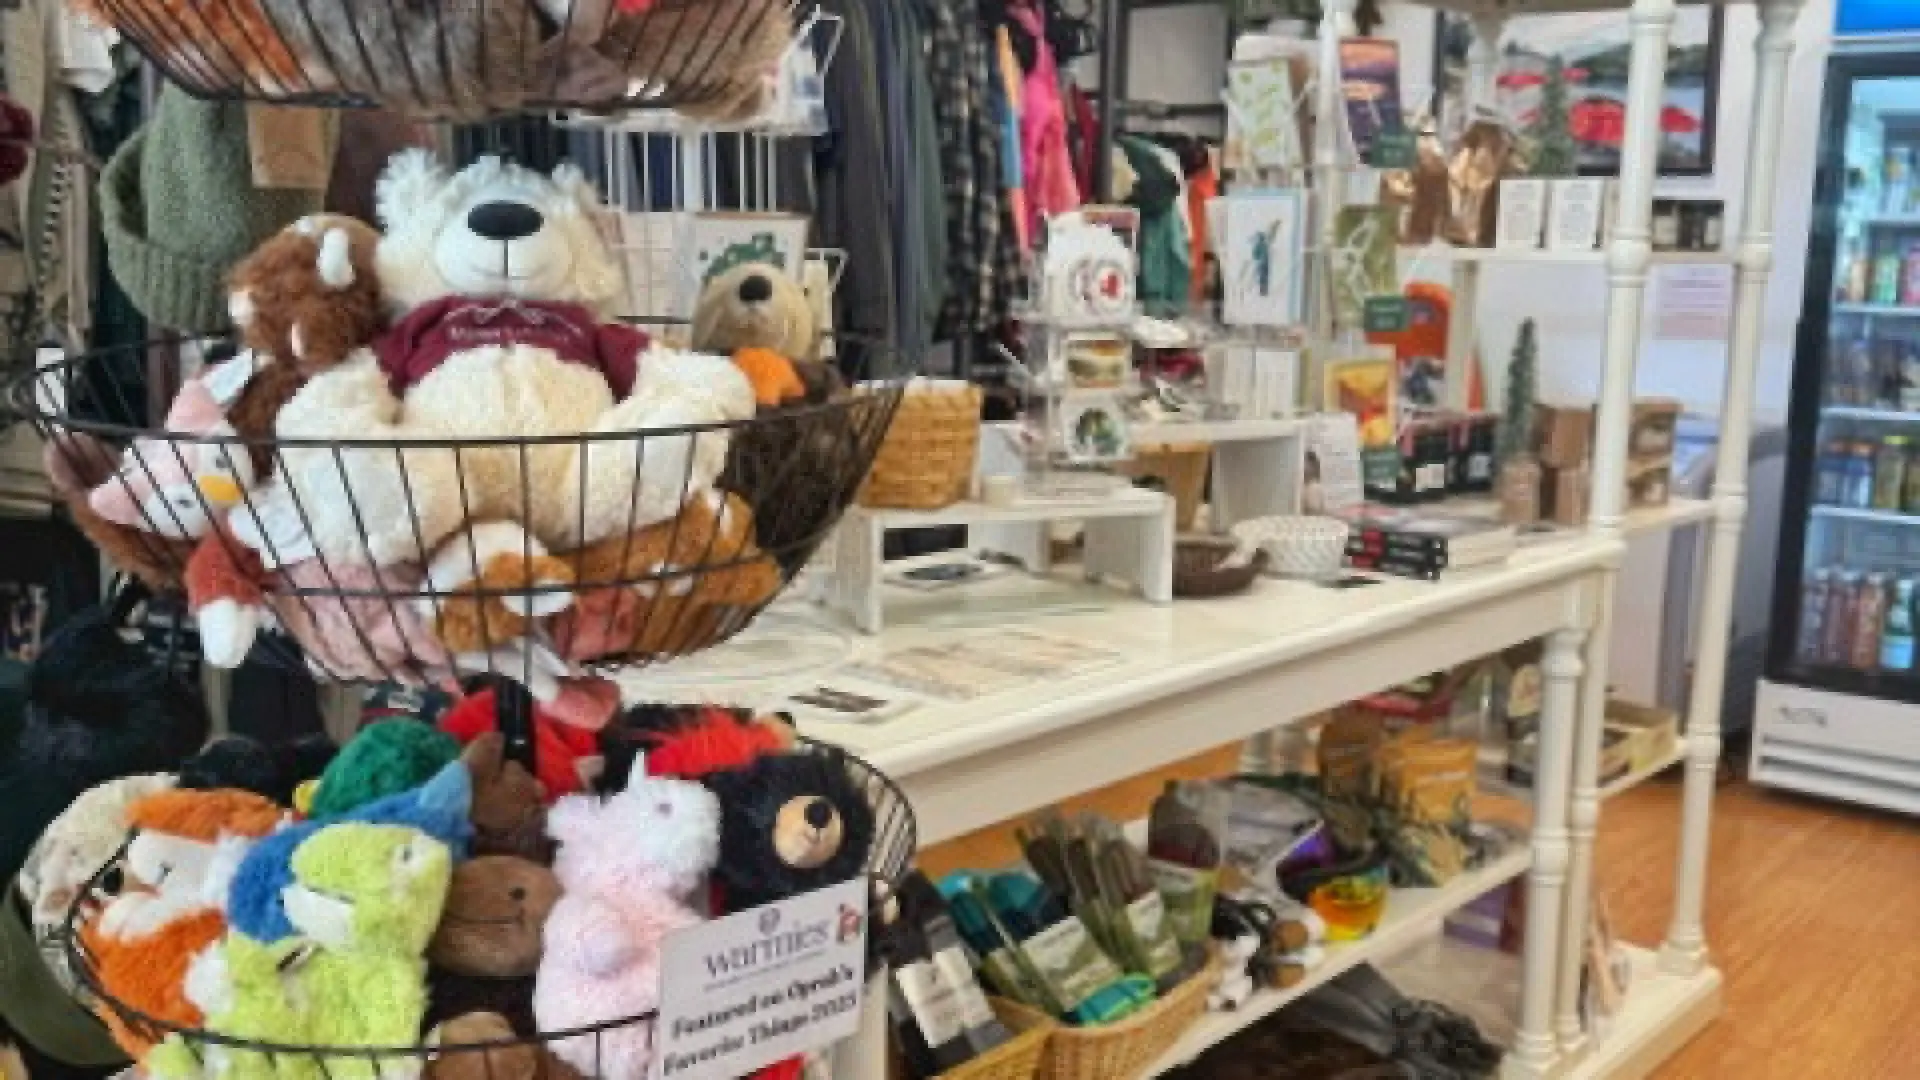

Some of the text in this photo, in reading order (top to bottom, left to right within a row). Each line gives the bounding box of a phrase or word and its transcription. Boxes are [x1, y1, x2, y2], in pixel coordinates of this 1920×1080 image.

[664, 1036, 744, 1075] Favorite
[748, 1014, 808, 1044] Things
[672, 997, 756, 1040] Featured
